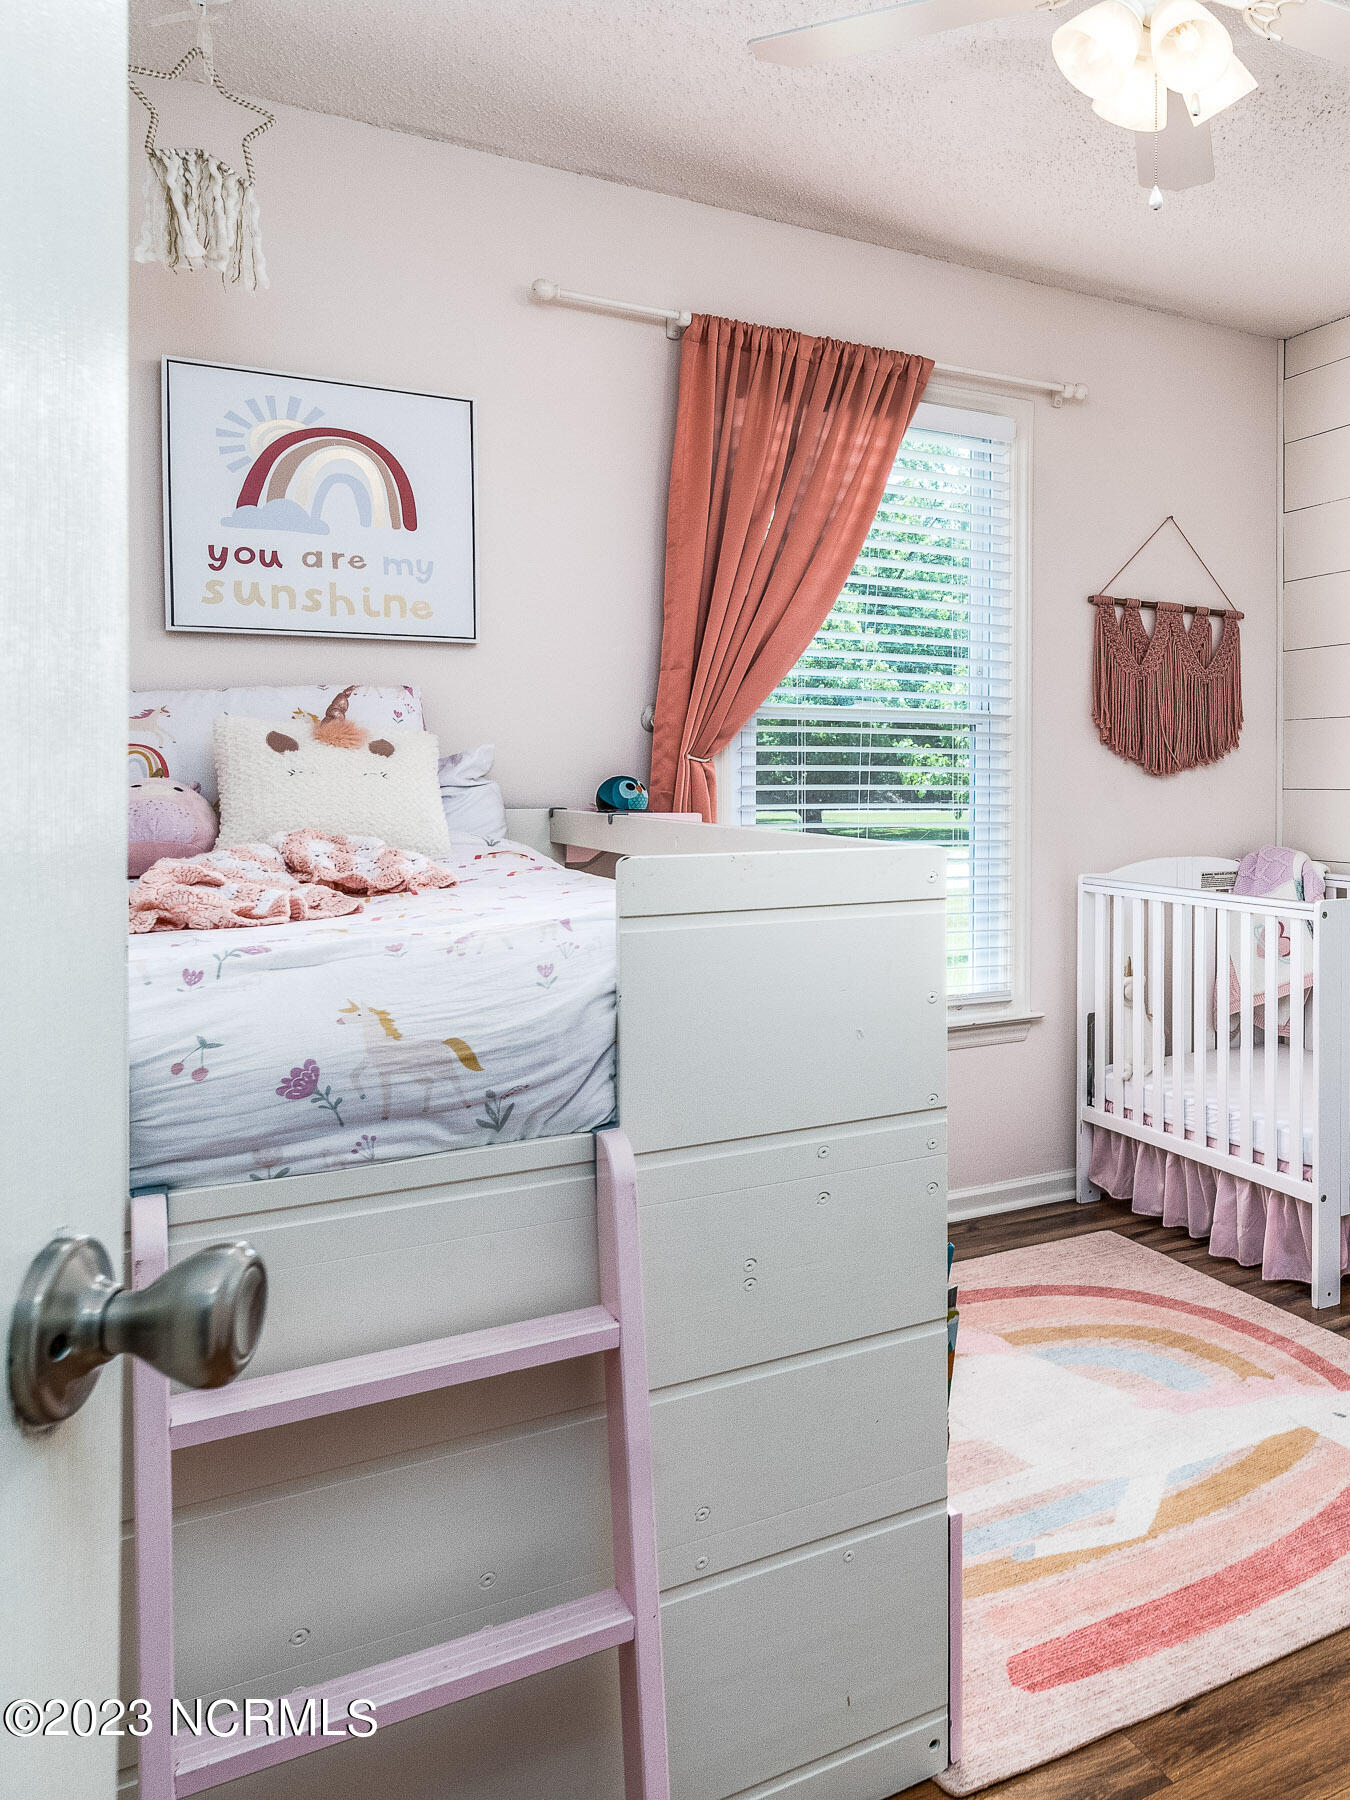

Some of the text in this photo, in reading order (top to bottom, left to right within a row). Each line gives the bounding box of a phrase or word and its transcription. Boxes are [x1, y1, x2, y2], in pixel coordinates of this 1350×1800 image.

[207, 544, 434, 583] you are my
[201, 579, 434, 620] sunshine
